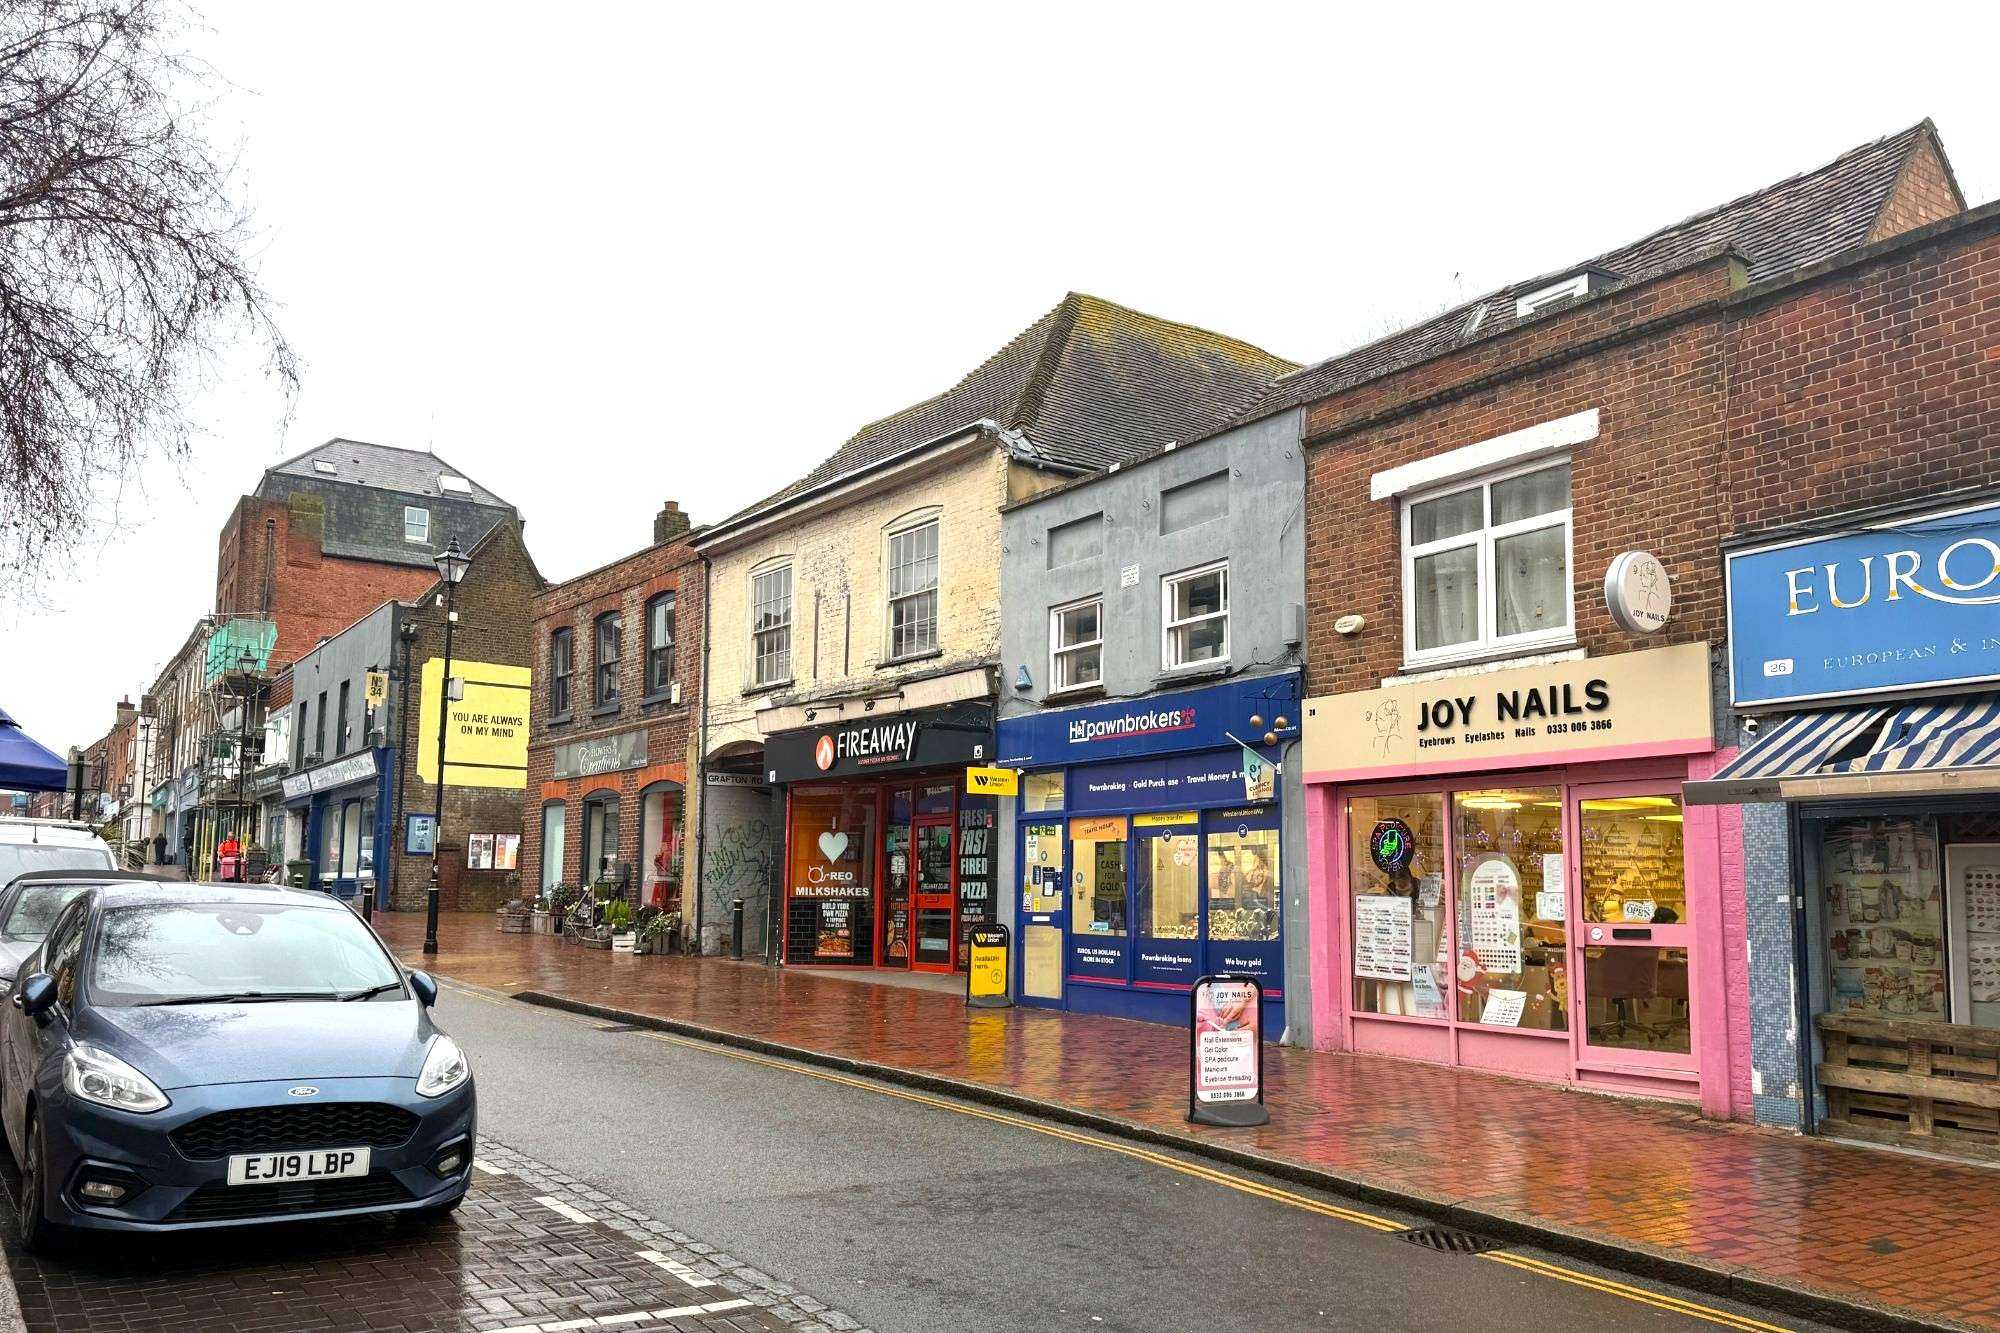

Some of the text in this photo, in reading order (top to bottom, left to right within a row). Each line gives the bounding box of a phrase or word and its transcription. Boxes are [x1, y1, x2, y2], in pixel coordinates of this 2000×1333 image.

[1633, 610, 1665, 622] JOY NAILS
[1822, 645, 1937, 670] EUROPEAN
[1950, 638, 1967, 655] &
[1770, 663, 1786, 673] 26
[370, 687, 383, 697] 34
[1417, 679, 1610, 731] JOY NAILS
[453, 712, 523, 726] YOU ARE ALWAYS
[461, 726, 514, 737] ON MY MIND
[1419, 719, 1612, 748] Eyebrows Eyelashes Nails 0333 006 3866
[837, 720, 917, 760] FIREAWAY
[708, 774, 748, 784] GRAFTON
[1089, 782, 1126, 792] Pawnbroking
[1133, 780, 1147, 789] Gold
[1187, 772, 1207, 783] Travel
[1208, 772, 1230, 783] Money
[960, 857, 988, 875] FIRED
[1101, 861, 1120, 869] CASH
[795, 887, 870, 897] MILKSHAKES
[960, 881, 988, 899] PIZZA
[1101, 883, 1120, 891] GOLD
[1627, 904, 1651, 917] OPEN
[1141, 954, 1192, 964] Pawnbroking loans
[1225, 957, 1262, 967] We buy gold
[245, 1152, 355, 1180] EJ19 LBP
